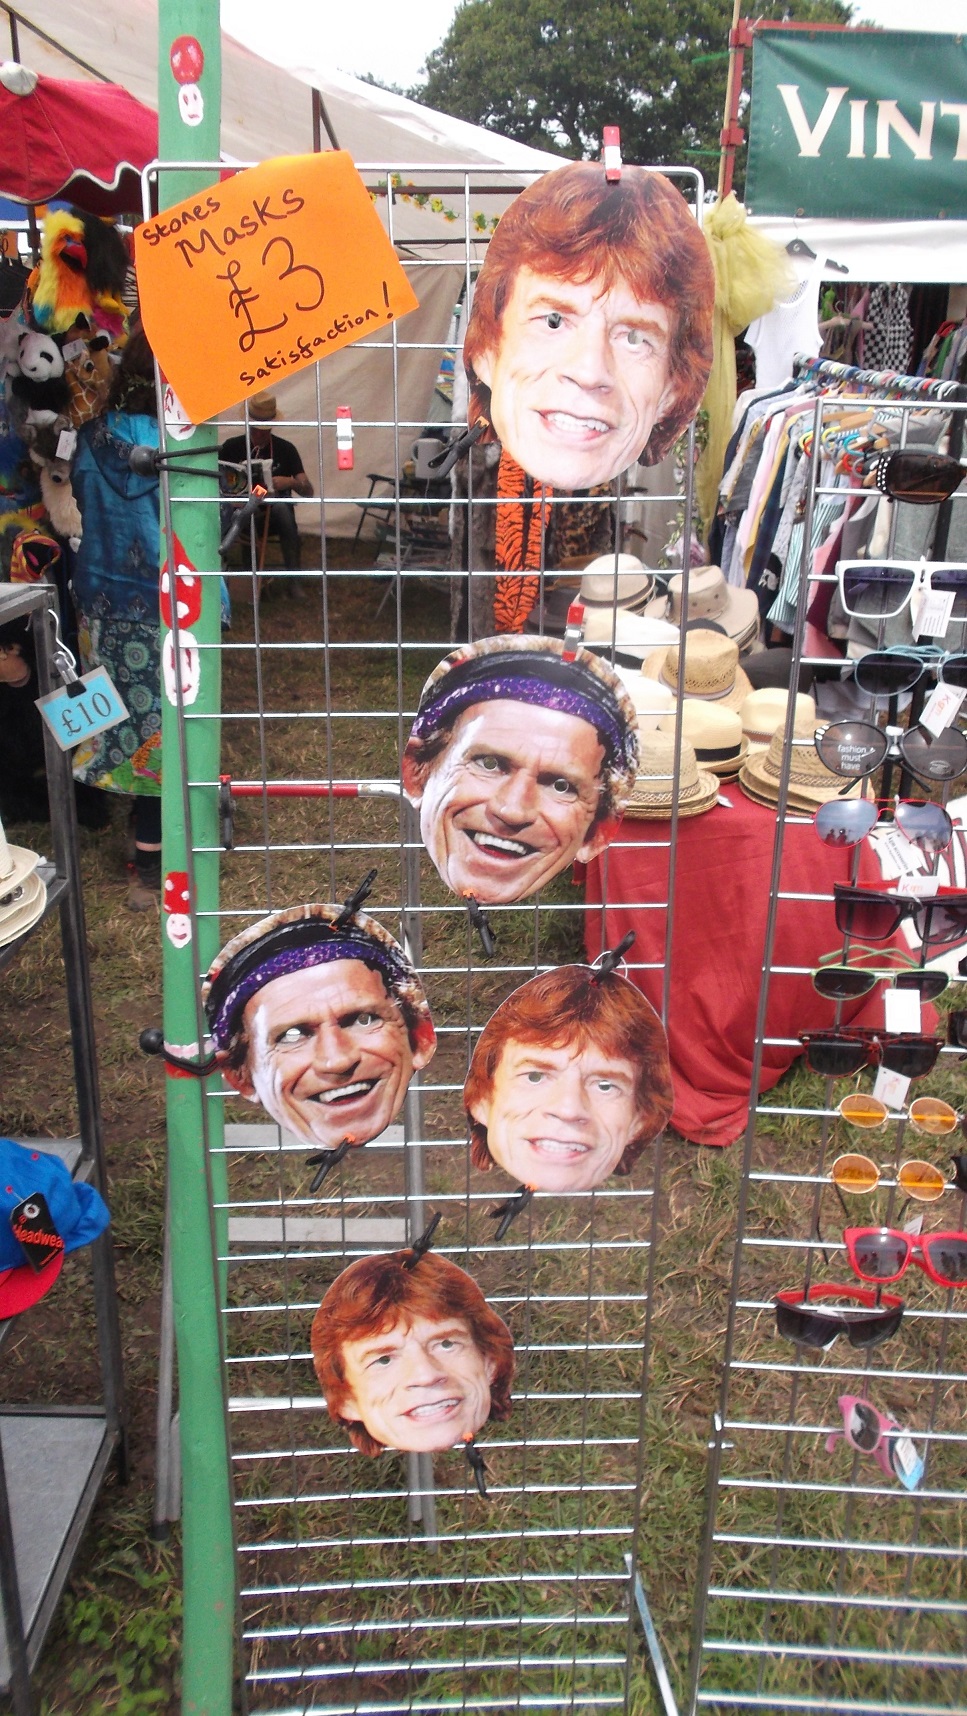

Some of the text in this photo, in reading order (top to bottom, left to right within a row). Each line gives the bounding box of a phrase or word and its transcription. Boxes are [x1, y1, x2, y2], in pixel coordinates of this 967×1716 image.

[216, 236, 325, 353] £3
[61, 692, 112, 737] £10
[837, 744, 867, 754] fashion
[841, 754, 862, 762] must
[840, 761, 861, 770] have
